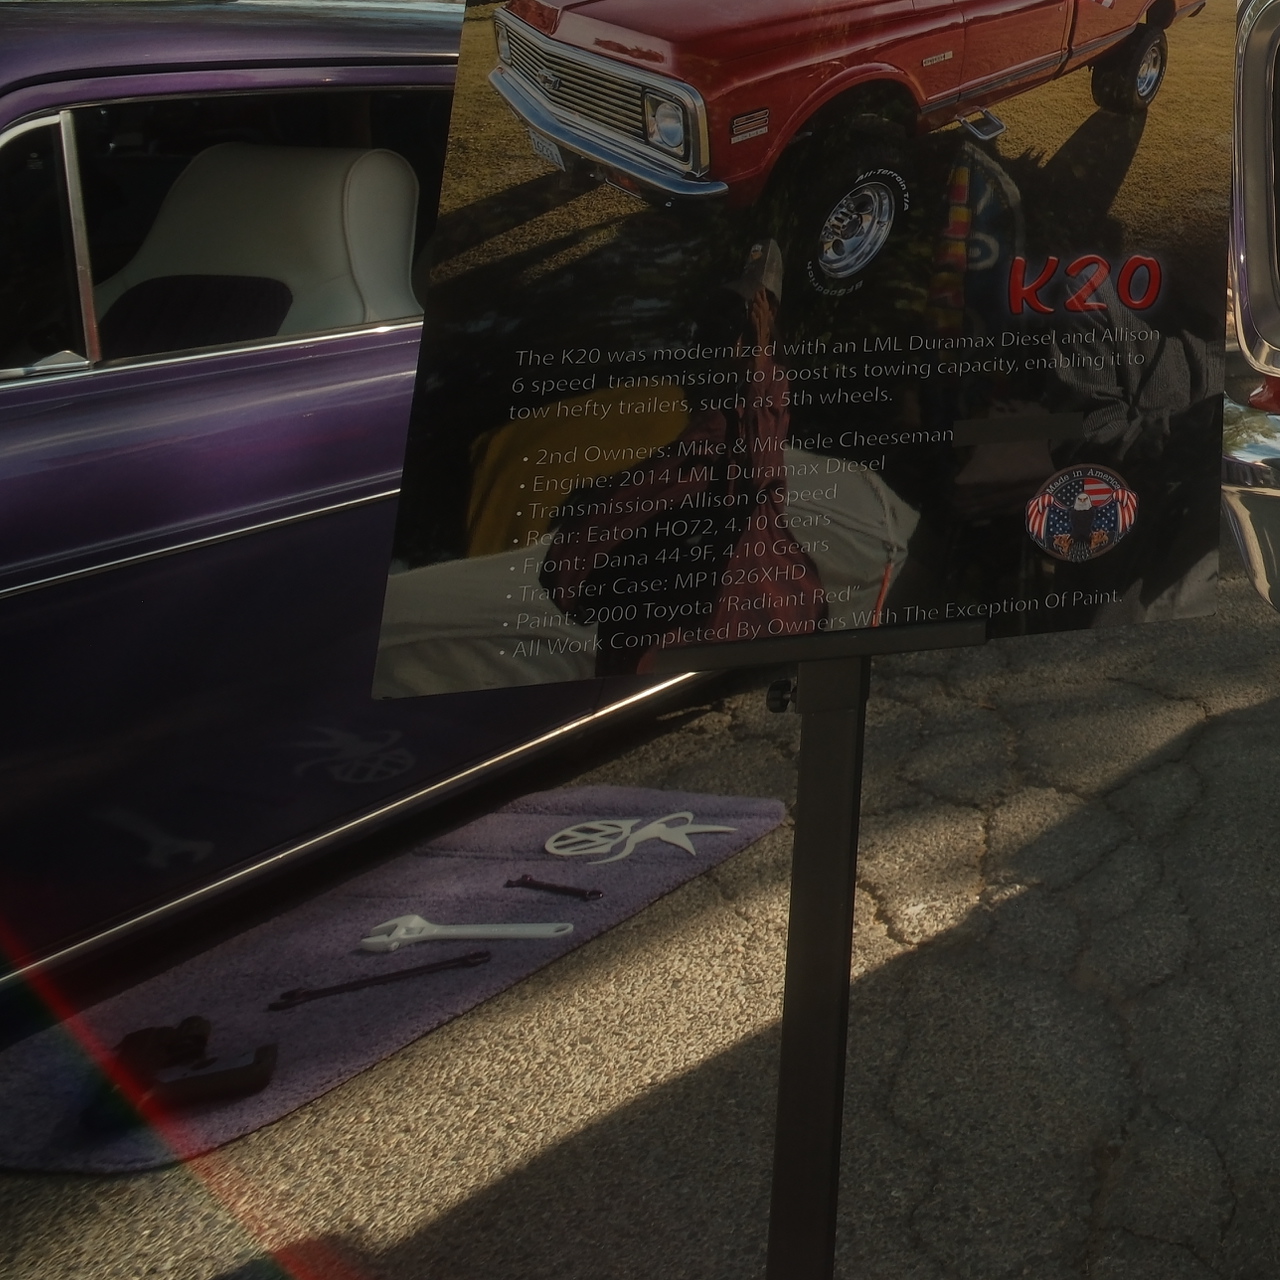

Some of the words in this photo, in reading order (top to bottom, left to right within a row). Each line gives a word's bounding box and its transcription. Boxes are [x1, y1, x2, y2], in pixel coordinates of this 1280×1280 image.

[1008, 254, 1162, 315] K20
[516, 350, 554, 366] The
[562, 348, 600, 364] K20
[608, 350, 646, 362] was
[654, 340, 776, 360] modernized
[783, 338, 826, 356] with
[832, 342, 856, 354] an
[864, 336, 902, 352] LML
[910, 336, 994, 350] Duramax
[1002, 330, 1056, 347] Diesel
[1062, 328, 1096, 344] and
[1102, 327, 1160, 342] Allison
[512, 378, 524, 394] 6
[532, 374, 596, 396] speed
[609, 372, 738, 388] transmission
[746, 368, 766, 382] to
[772, 366, 828, 382] boost
[836, 364, 857, 378] its
[864, 364, 930, 379] towing
[938, 358, 1018, 377] capacity,
[1024, 352, 1104, 370] enabling
[1110, 352, 1120, 366] it
[1128, 352, 1144, 365] to
[510, 406, 550, 420] tow
[556, 400, 612, 420] hefty
[619, 397, 692, 414] trailers,
[700, 393, 746, 410] such
[752, 396, 773, 408] as
[780, 390, 812, 406] 5th
[820, 386, 892, 404] wheels.
[536, 446, 577, 464] 2nd
[584, 446, 670, 462] Owners:
[678, 440, 726, 456] Mike
[732, 438, 747, 454] &
[754, 433, 833, 452] Michele
[839, 430, 954, 448] Cheeseman
[533, 474, 613, 494] Engine:
[620, 468, 670, 486] 2014
[678, 466, 719, 483] LML
[726, 464, 818, 480] Duramax
[826, 454, 885, 474] Diesel
[1046, 474, 1070, 494] Made
[1072, 469, 1083, 478] in
[1086, 468, 1120, 489] America
[529, 496, 674, 519] Transmission:
[680, 492, 748, 509] Allison
[756, 489, 767, 504] 6
[774, 484, 837, 506] Speed
[526, 528, 580, 546] Rear:
[587, 526, 647, 542] Eaton
[724, 515, 768, 532] 4.10
[774, 514, 830, 528] Gears
[524, 556, 586, 573] Front:
[594, 552, 648, 569] Dana
[655, 544, 716, 564] 44-9F,
[722, 542, 766, 558] 4.10
[772, 539, 829, 555] Gears
[518, 580, 606, 602] Transfer
[612, 578, 668, 594] Case:
[674, 564, 806, 589] MP1626XHD
[512, 639, 540, 658] All
[548, 634, 602, 654] Work
[610, 622, 730, 649] Completed
[737, 622, 762, 640] By
[768, 618, 846, 634] Owners
[852, 606, 897, 626] With
[904, 605, 938, 622] The
[946, 598, 1038, 618] Exception
[1044, 592, 1067, 608] Of
[1072, 590, 1122, 606] Paint.
[516, 611, 576, 630] Paint:
[584, 604, 637, 624] 2000
[643, 600, 712, 622] Toyota
